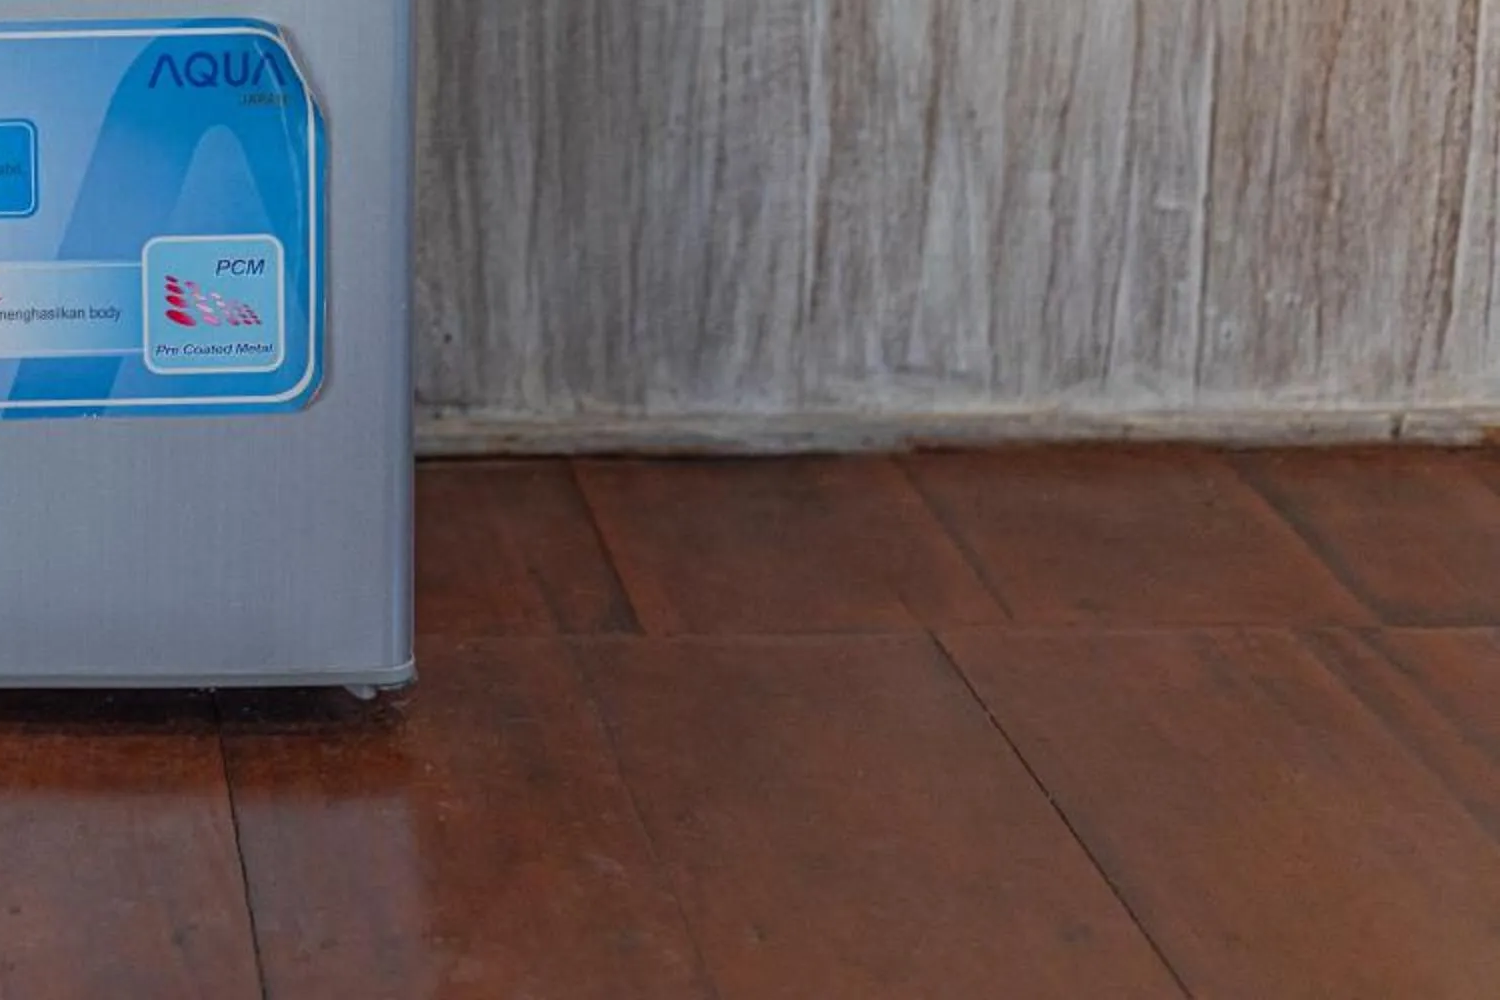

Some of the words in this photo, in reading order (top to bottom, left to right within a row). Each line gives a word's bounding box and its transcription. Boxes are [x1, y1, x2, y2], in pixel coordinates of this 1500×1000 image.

[148, 50, 287, 89] AQUA
[215, 259, 266, 277] PCM
[89, 304, 123, 322] body
[155, 343, 179, 357] Pre
[183, 342, 234, 355] Coated
[235, 342, 274, 355] Metal
